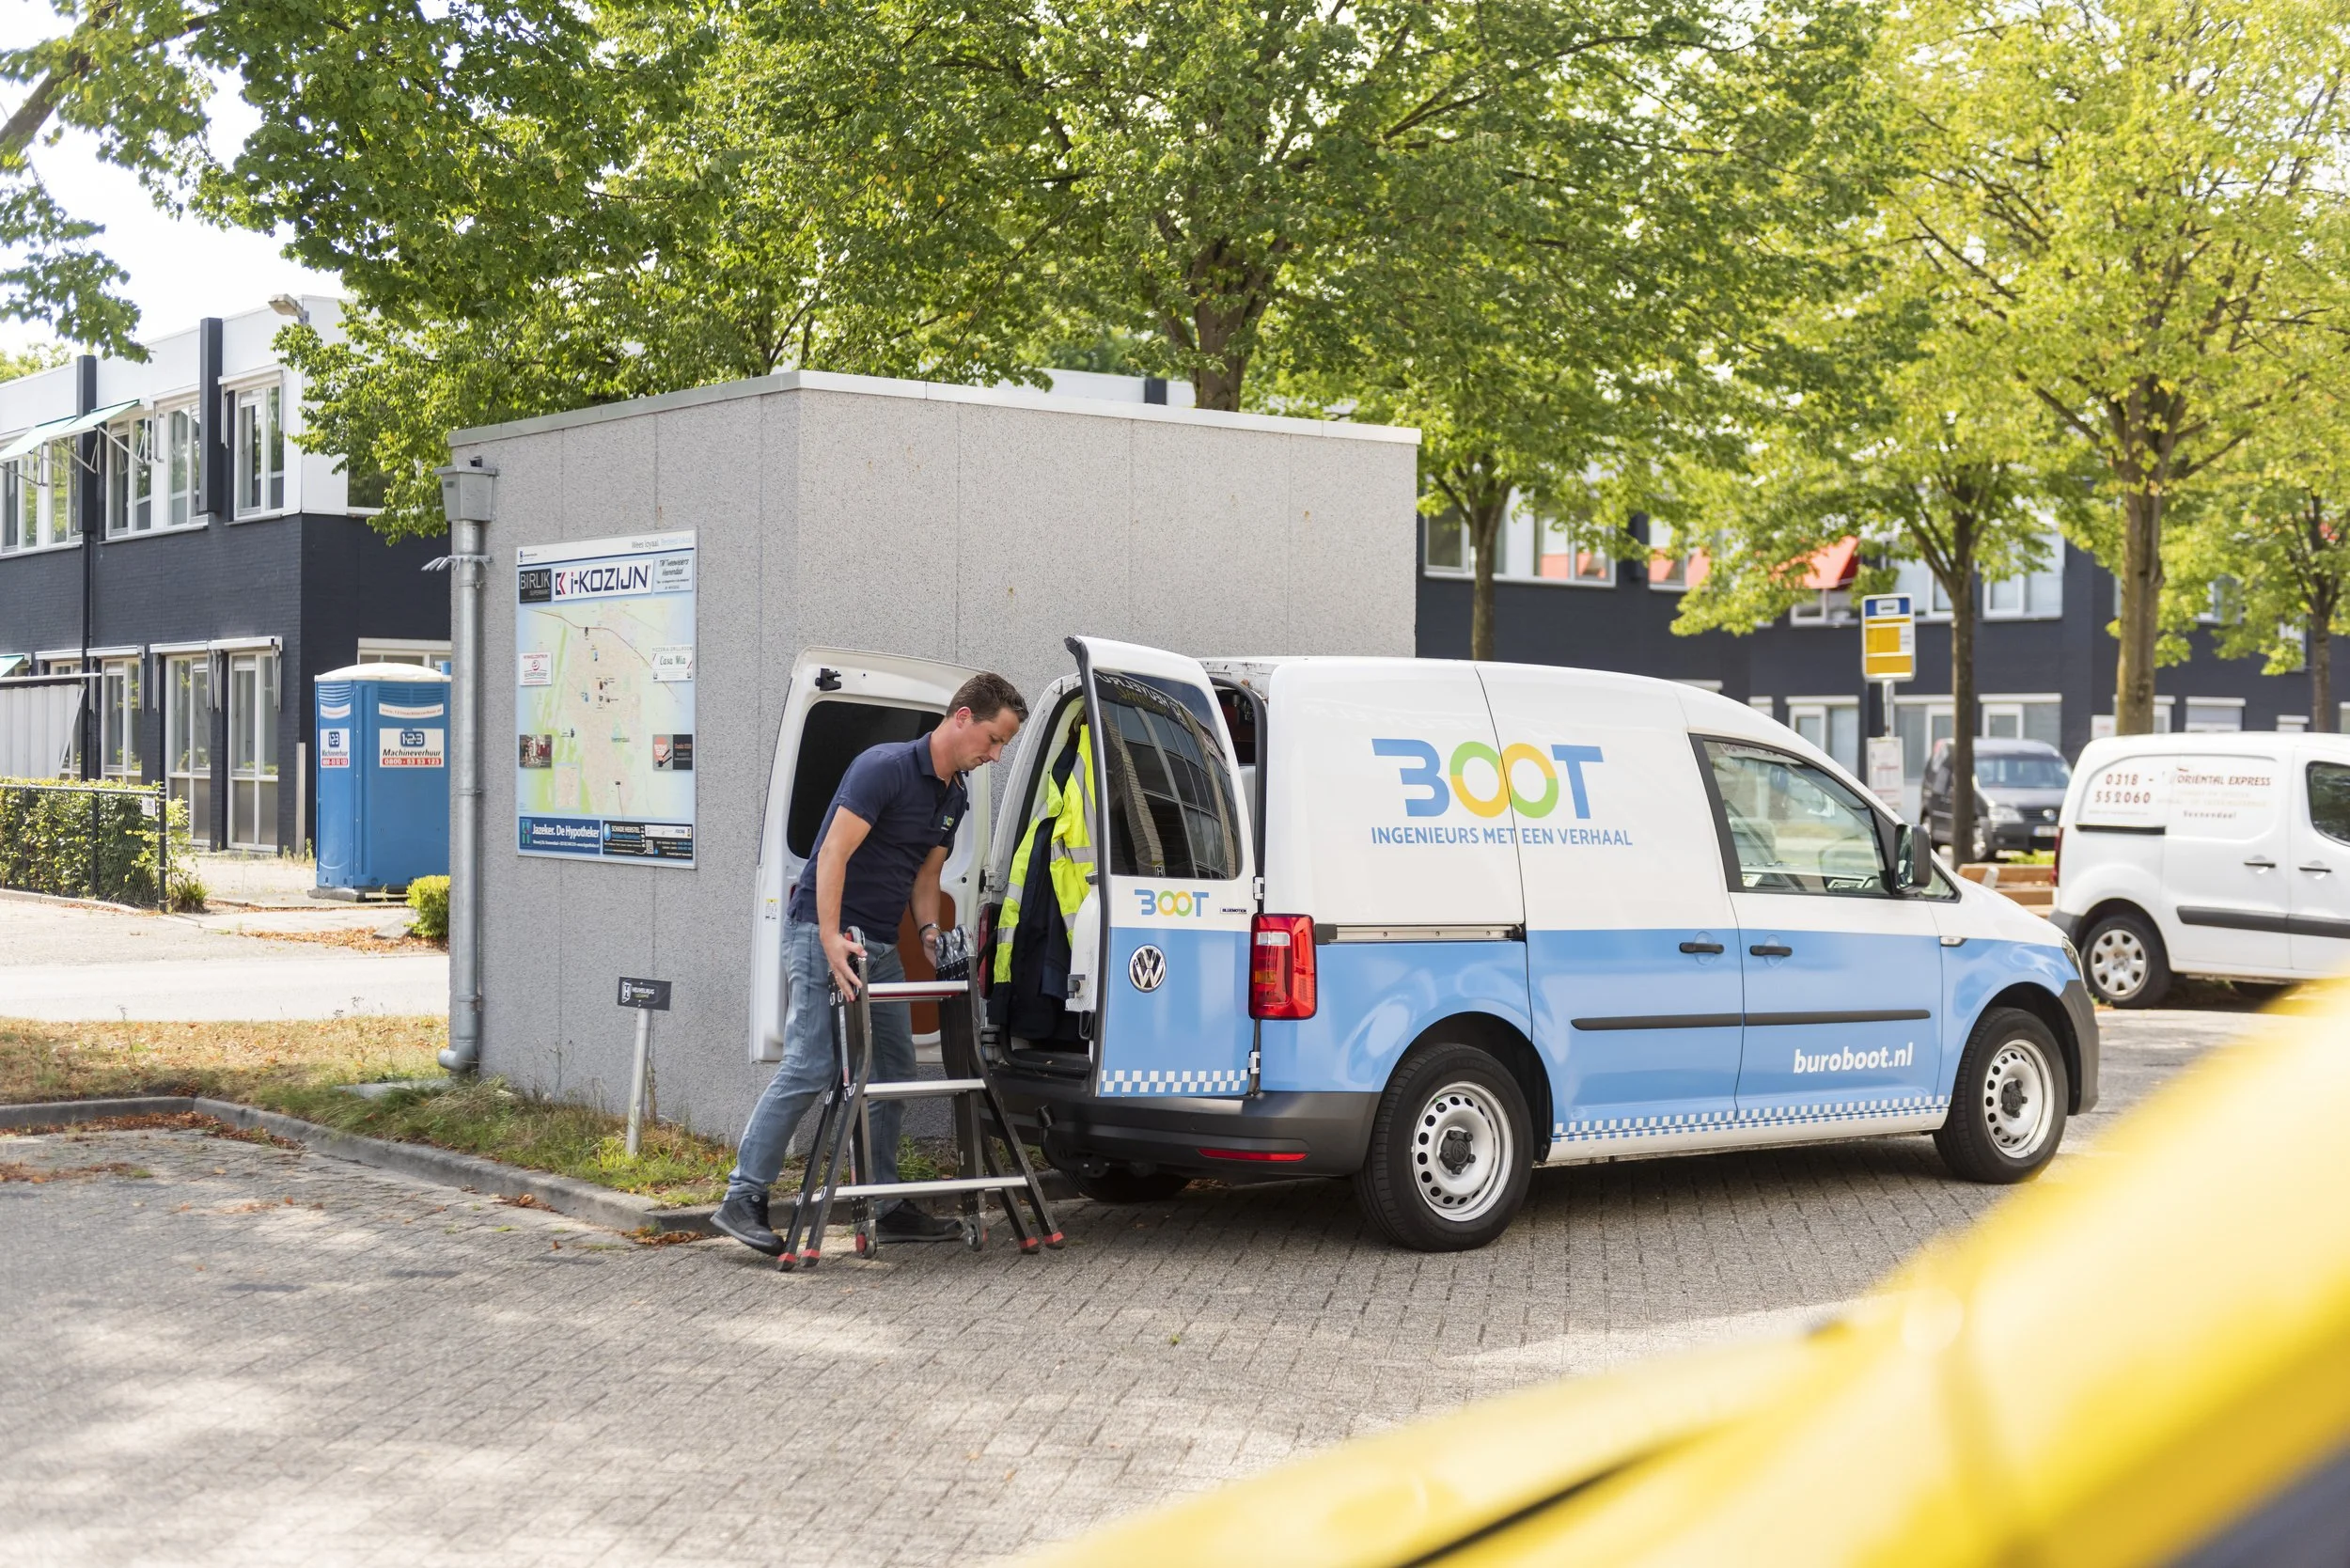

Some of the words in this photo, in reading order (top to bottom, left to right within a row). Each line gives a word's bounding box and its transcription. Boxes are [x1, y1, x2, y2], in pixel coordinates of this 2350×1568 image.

[520, 572, 551, 589] BIRLIK
[571, 564, 649, 594] i-KOZIJN
[660, 655, 673, 666] Casa
[676, 655, 686, 665] Mia
[382, 748, 442, 757] Machineverhuur
[1371, 738, 1604, 819] BOOT
[2105, 774, 2139, 786] 0318
[2176, 775, 2226, 786] ORIENTAL
[2228, 776, 2272, 787] EXPRESS
[532, 823, 556, 836] Jazeker.
[556, 824, 565, 836] De
[565, 825, 600, 839] Hypotheker
[1371, 826, 1480, 844] INGENIEURS
[1483, 827, 1516, 844] MET
[1522, 828, 1555, 844] EEN
[1559, 828, 1634, 846] VERHAAL
[1134, 889, 1210, 917] BOOT
[1794, 1042, 1914, 1074] buroboot.nl
